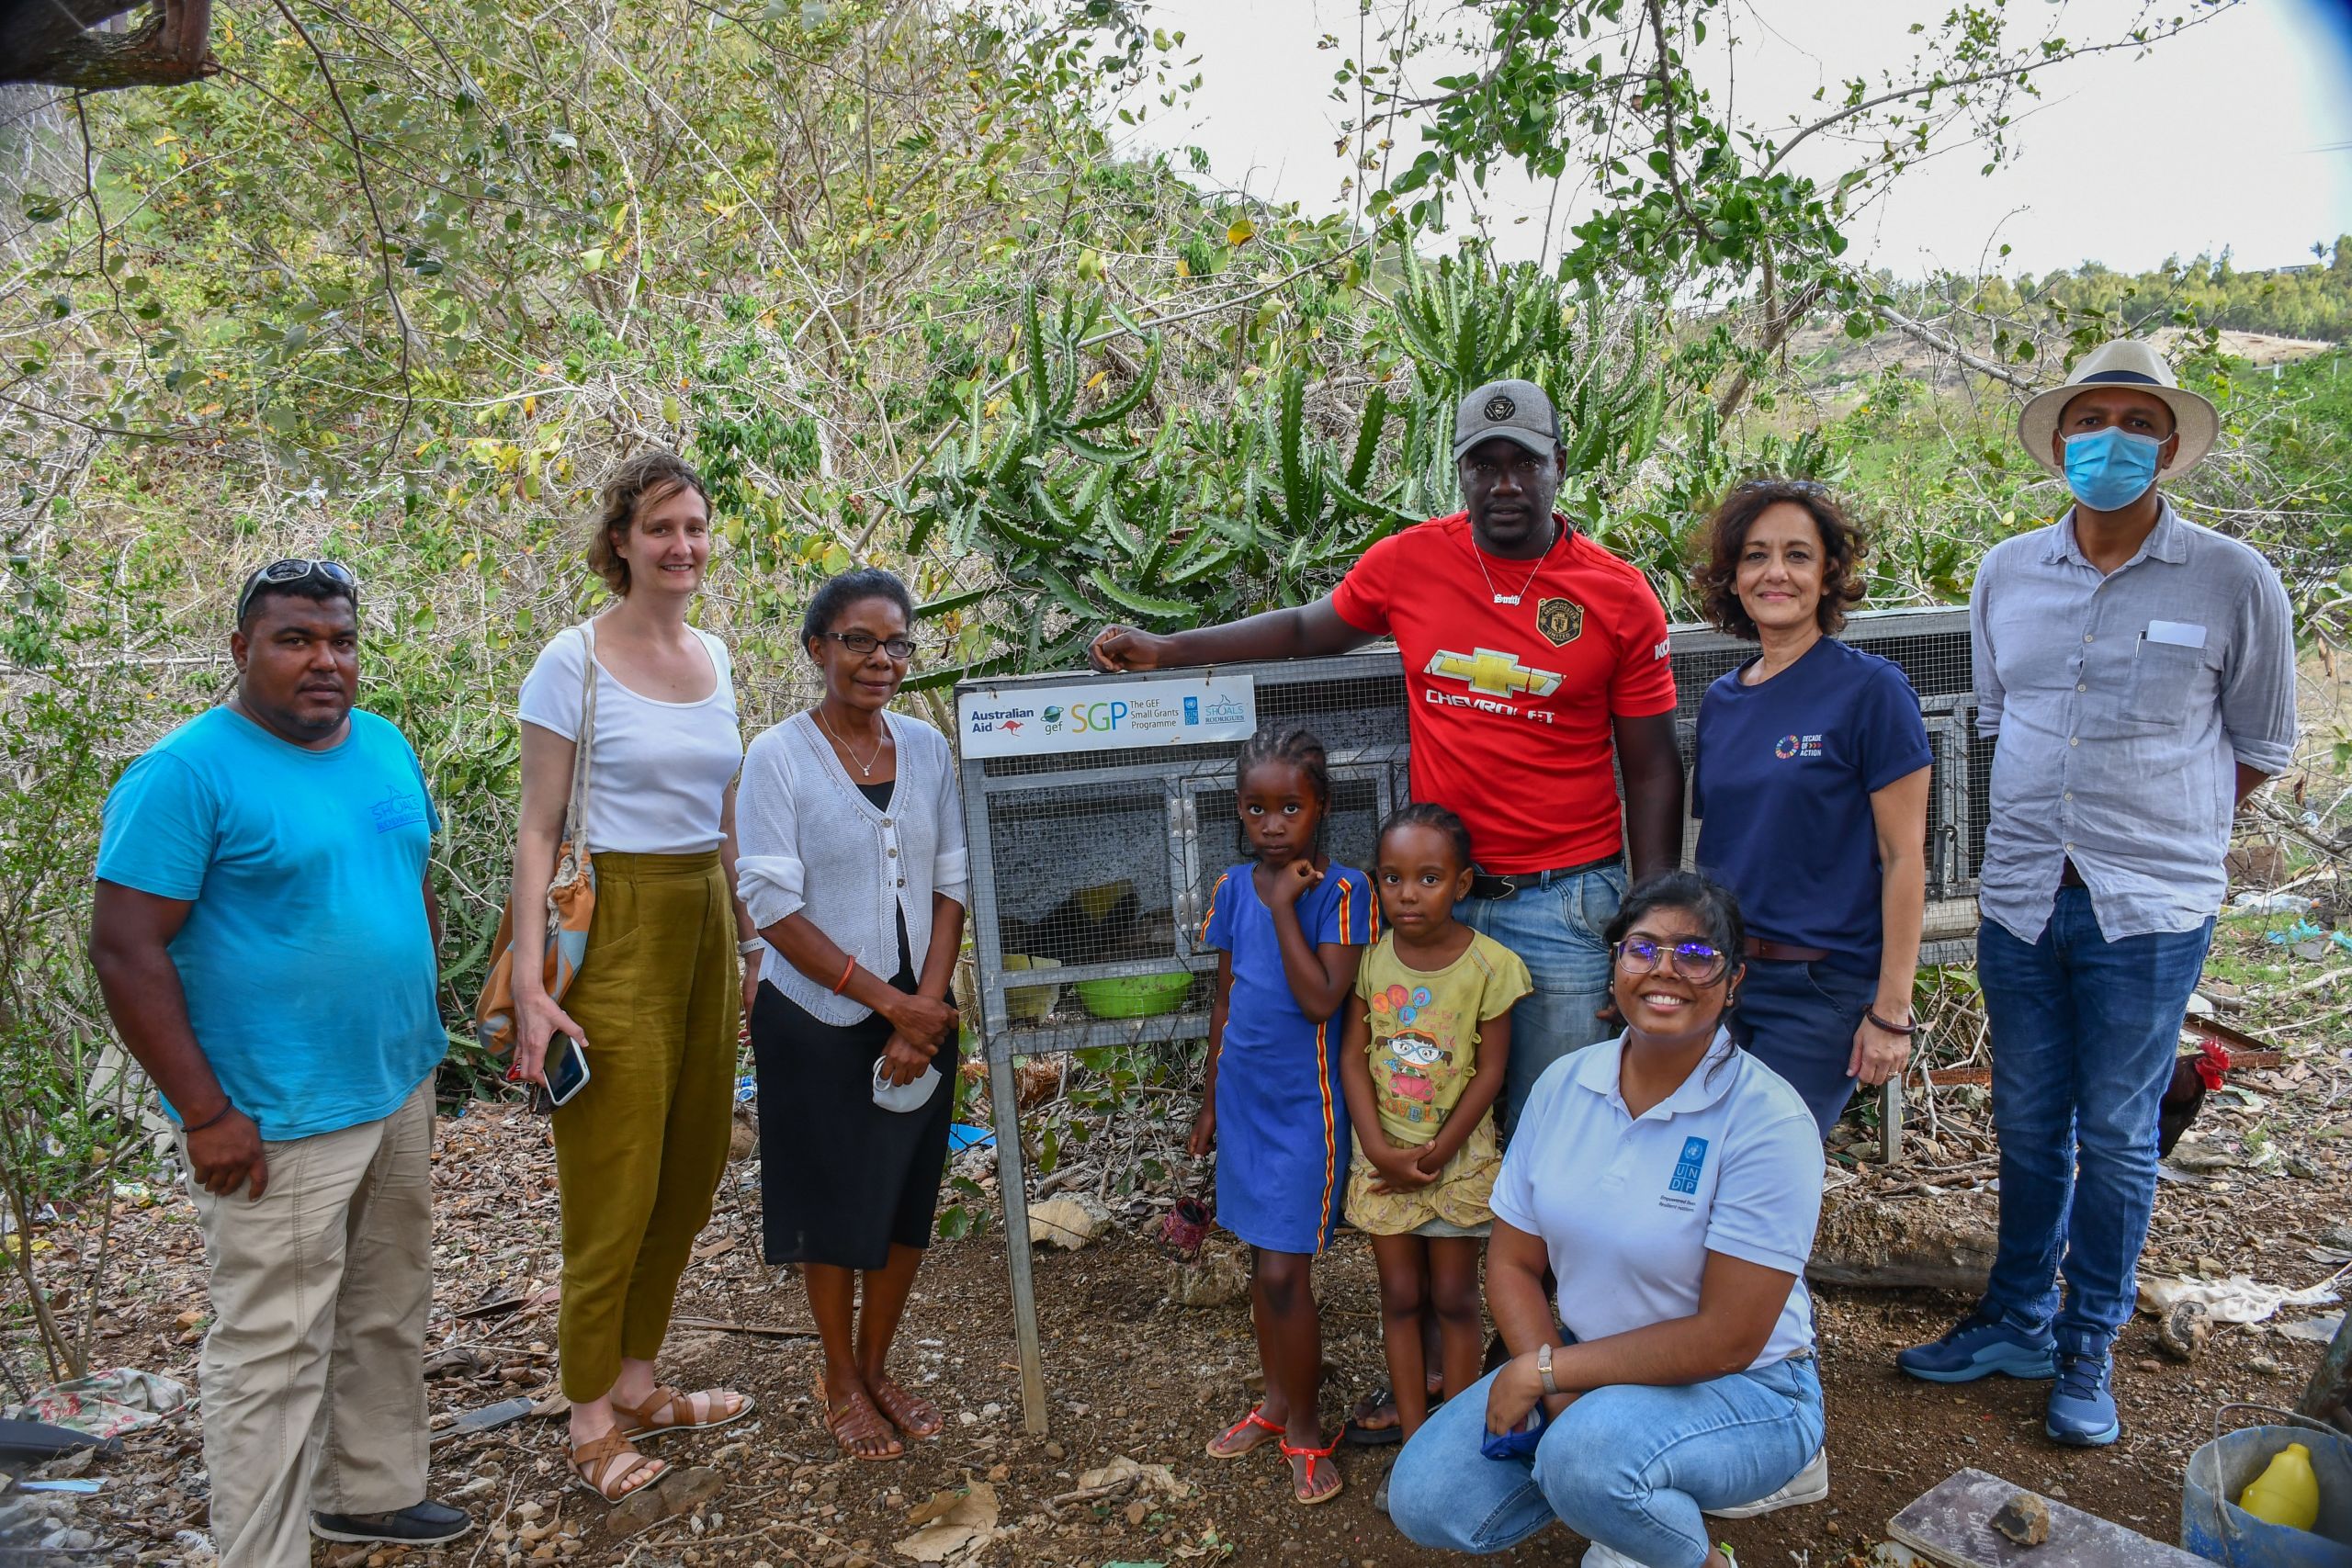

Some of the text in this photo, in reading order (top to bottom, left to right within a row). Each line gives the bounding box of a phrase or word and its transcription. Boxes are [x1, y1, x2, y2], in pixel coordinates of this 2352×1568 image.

[1544, 604, 1577, 620] MANCHESTER
[1546, 629, 1571, 639] UNITED
[1130, 698, 1159, 708] The GEF
[971, 707, 1035, 721] Australian
[1130, 708, 1179, 719] Small Grants
[1204, 703, 1244, 716] SHOALS
[1070, 701, 1128, 733] SGP
[1204, 715, 1245, 723] RODRIGUES
[972, 722, 993, 733] Aid
[1045, 721, 1064, 736] gef
[1131, 719, 1176, 731] Programme
[1802, 734, 1822, 742] DECADE
[1799, 749, 1822, 757] ACTION
[371, 795, 420, 820] SHOALS
[1381, 1098, 1451, 1124] OVELY
